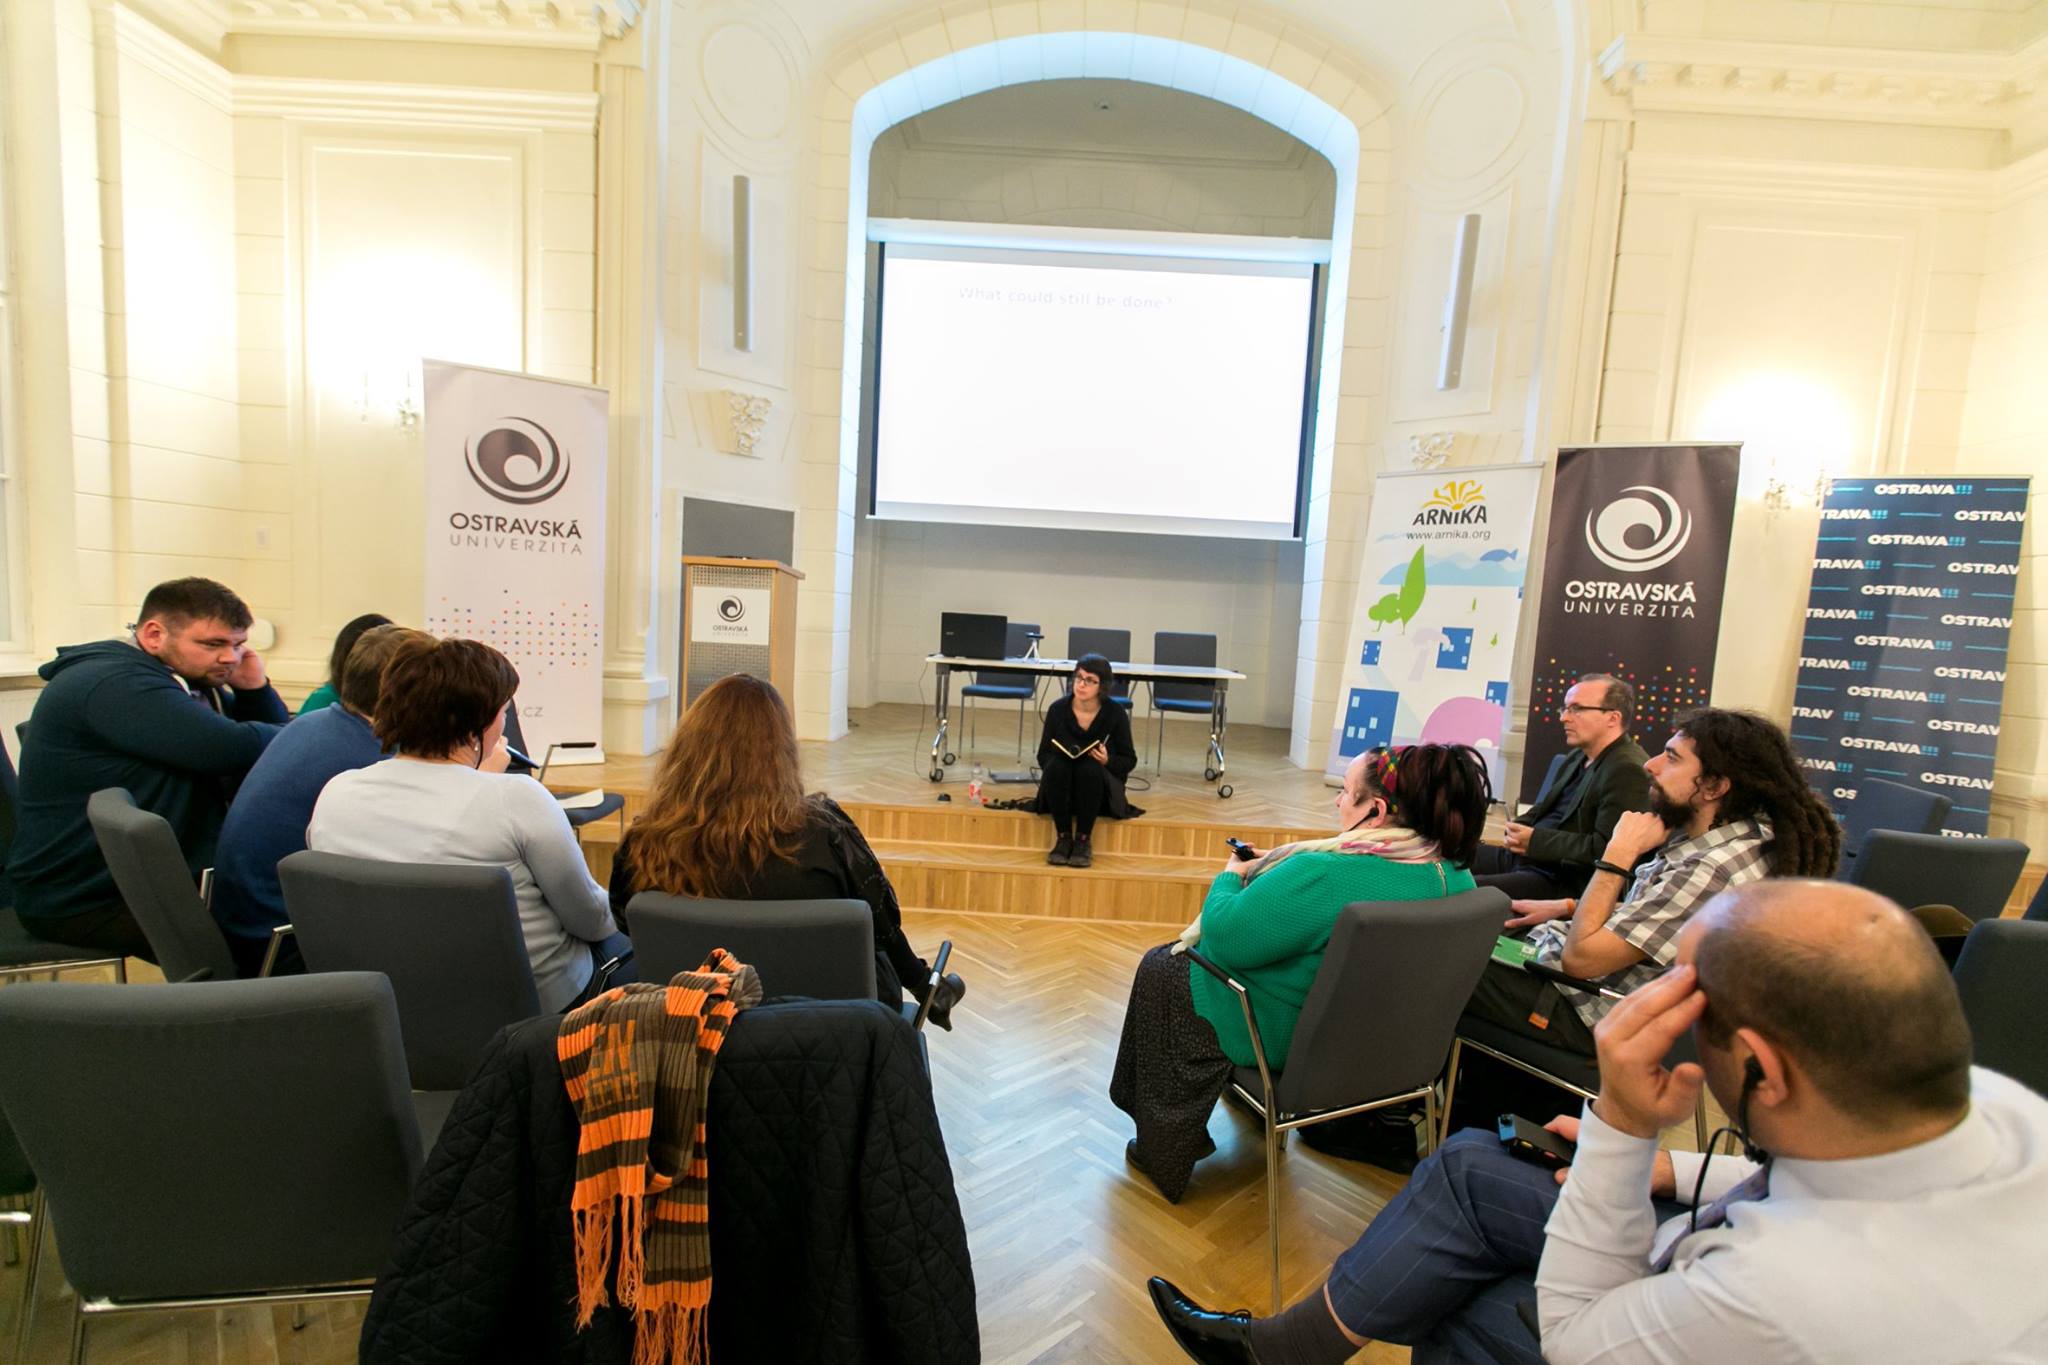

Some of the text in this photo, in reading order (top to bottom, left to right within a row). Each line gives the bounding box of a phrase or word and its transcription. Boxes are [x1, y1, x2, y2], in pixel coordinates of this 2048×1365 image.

[959, 287, 1174, 309] What could still be done?
[1874, 483, 1973, 496] OSTRAVA!!!
[449, 511, 583, 540] OSTRAVSKÁ
[449, 533, 583, 556] UNIVERZITA
[1406, 530, 1491, 541] www.arnika.org
[1867, 533, 1966, 547] OSTRAVA!!!
[1564, 580, 1697, 603] OSTRAVSKÁ
[1860, 584, 1959, 599] OSTRAVA!!!
[1563, 600, 1695, 619] UNIVERZITA
[1854, 634, 1953, 652] OSTRAVA!!!
[1846, 685, 1947, 704] OSTRAVA!!!
[1839, 736, 1939, 757] OSTRAVA!!!
